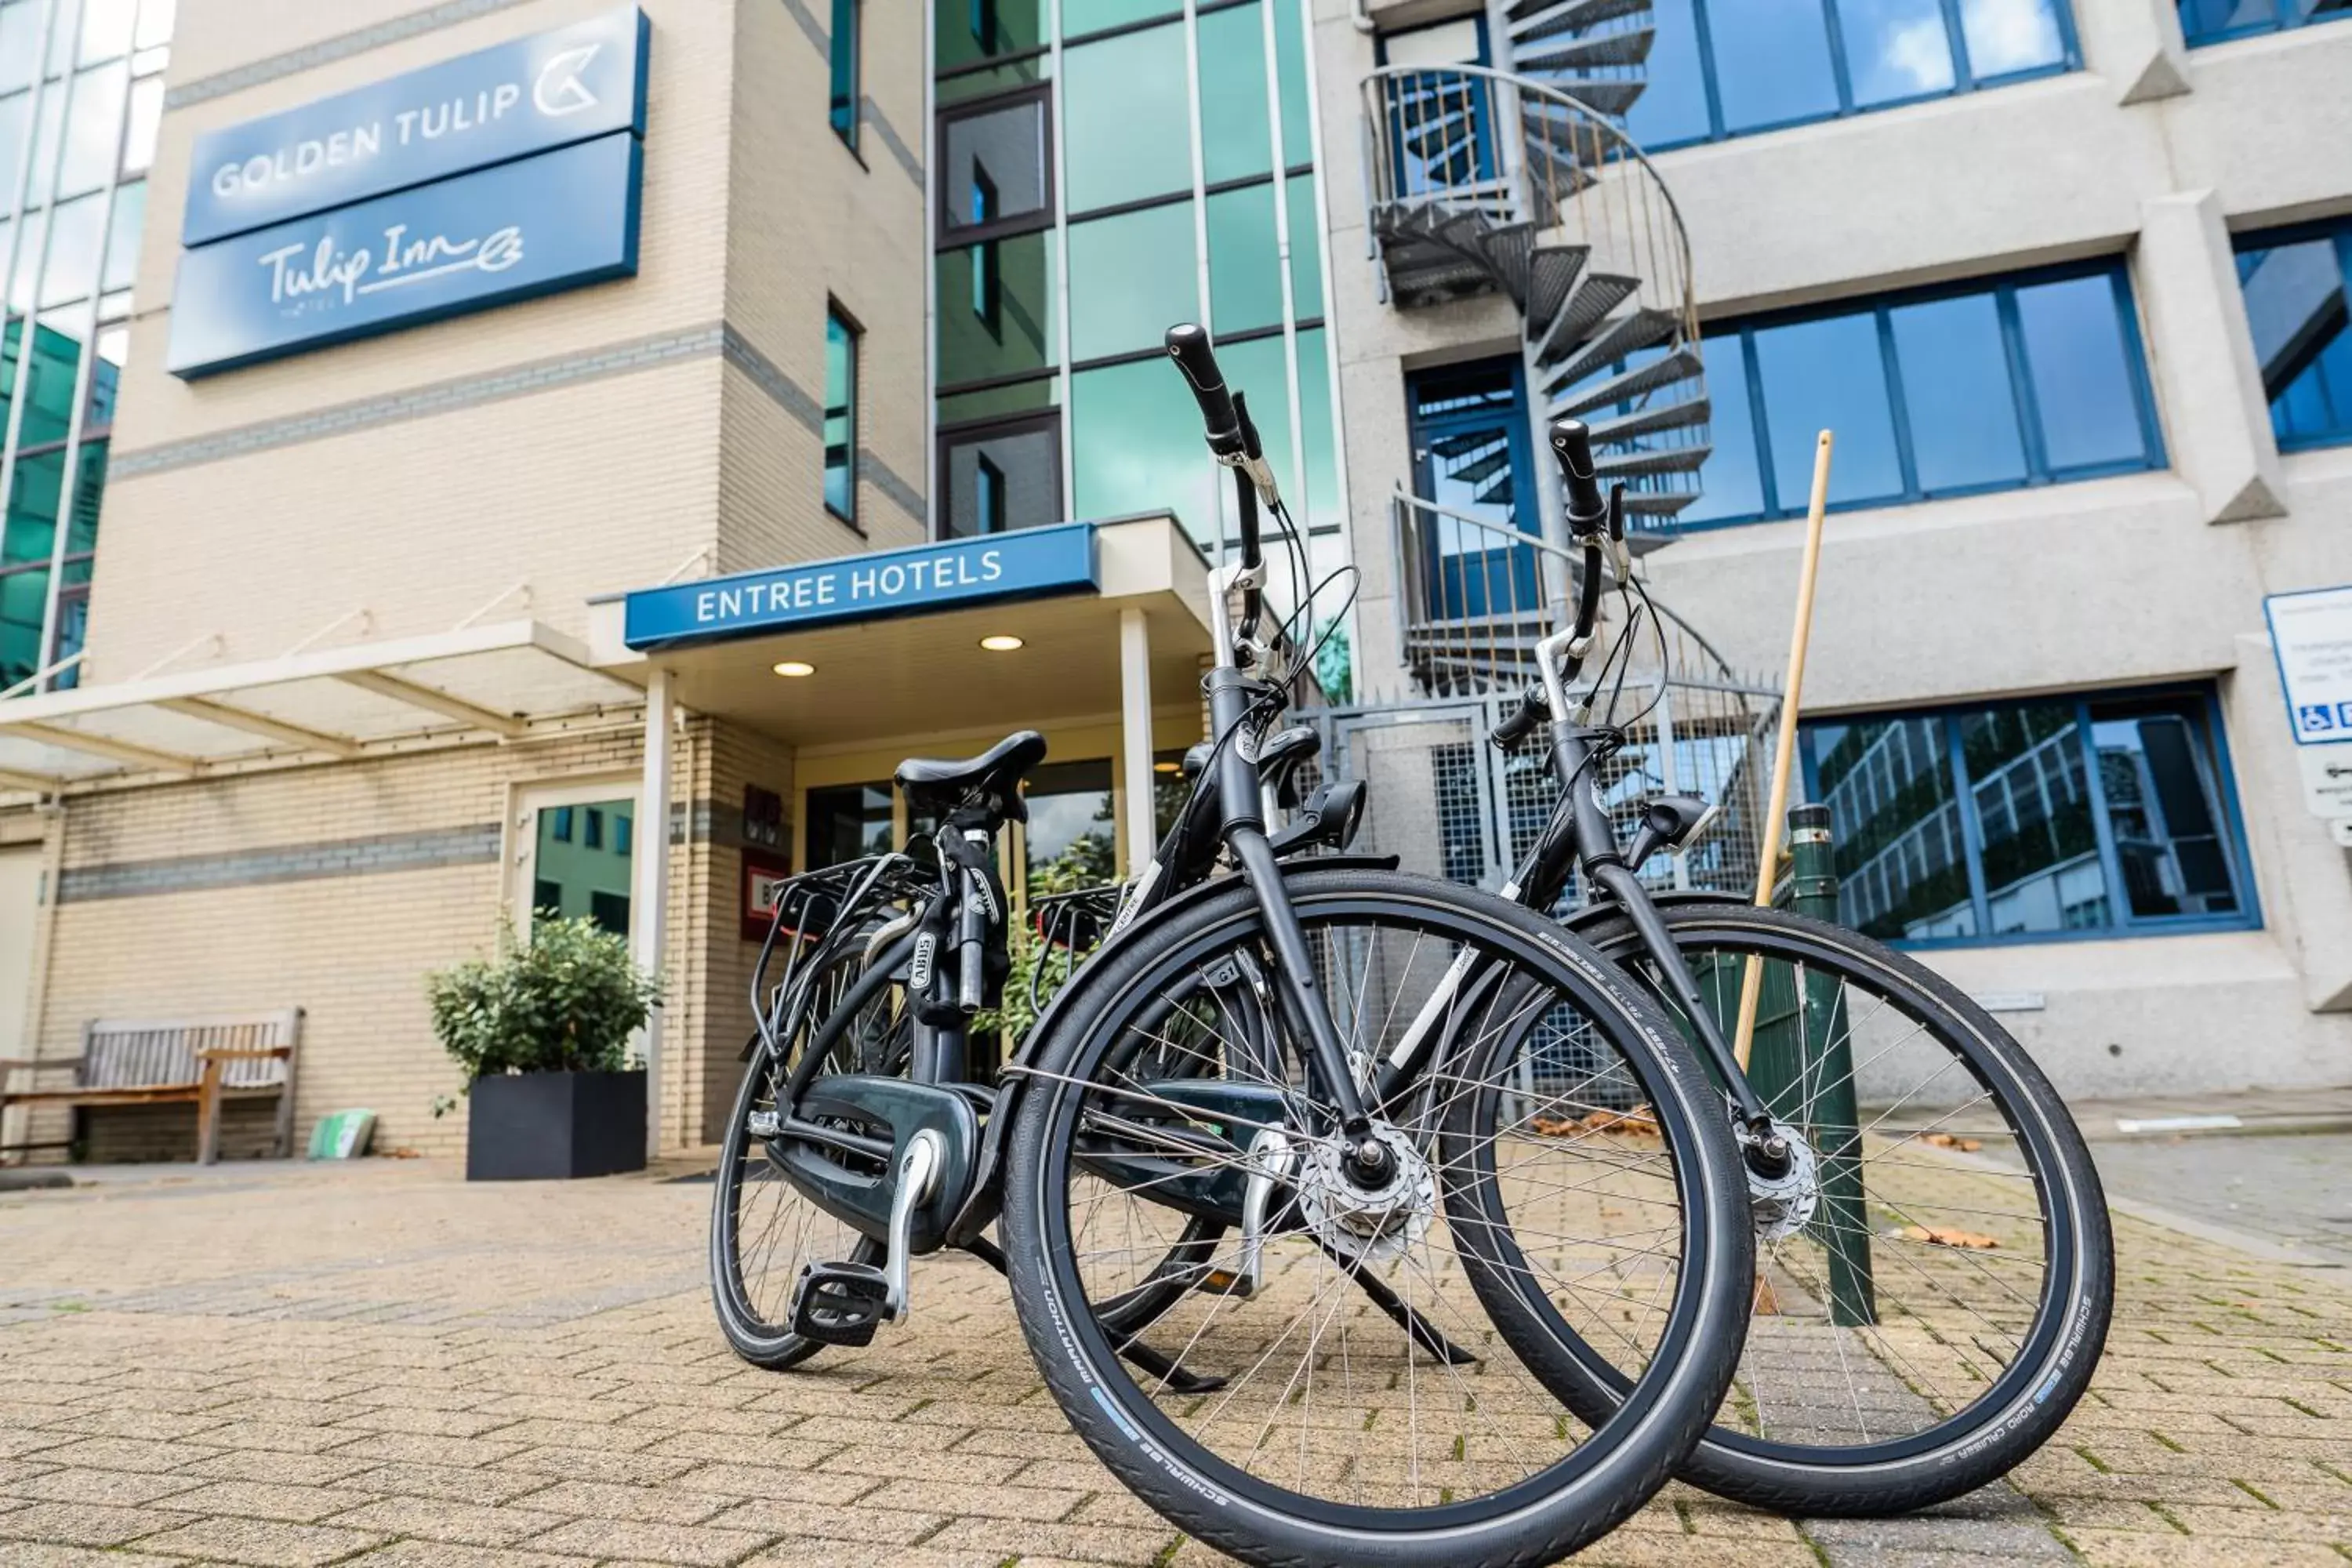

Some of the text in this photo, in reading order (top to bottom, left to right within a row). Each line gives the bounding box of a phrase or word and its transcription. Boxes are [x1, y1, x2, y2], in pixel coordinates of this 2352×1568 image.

[212, 83, 521, 197] GOLDEN TULIP
[258, 223, 480, 304] Tulip Inn
[697, 551, 1003, 622] ENTREE HOTELS
[916, 939, 930, 979] ABUS
[1044, 1290, 1093, 1384] MARATHON
[1958, 1402, 2035, 1459] ROAD CRUISER
[1139, 1443, 1230, 1507] SCHWALBE
